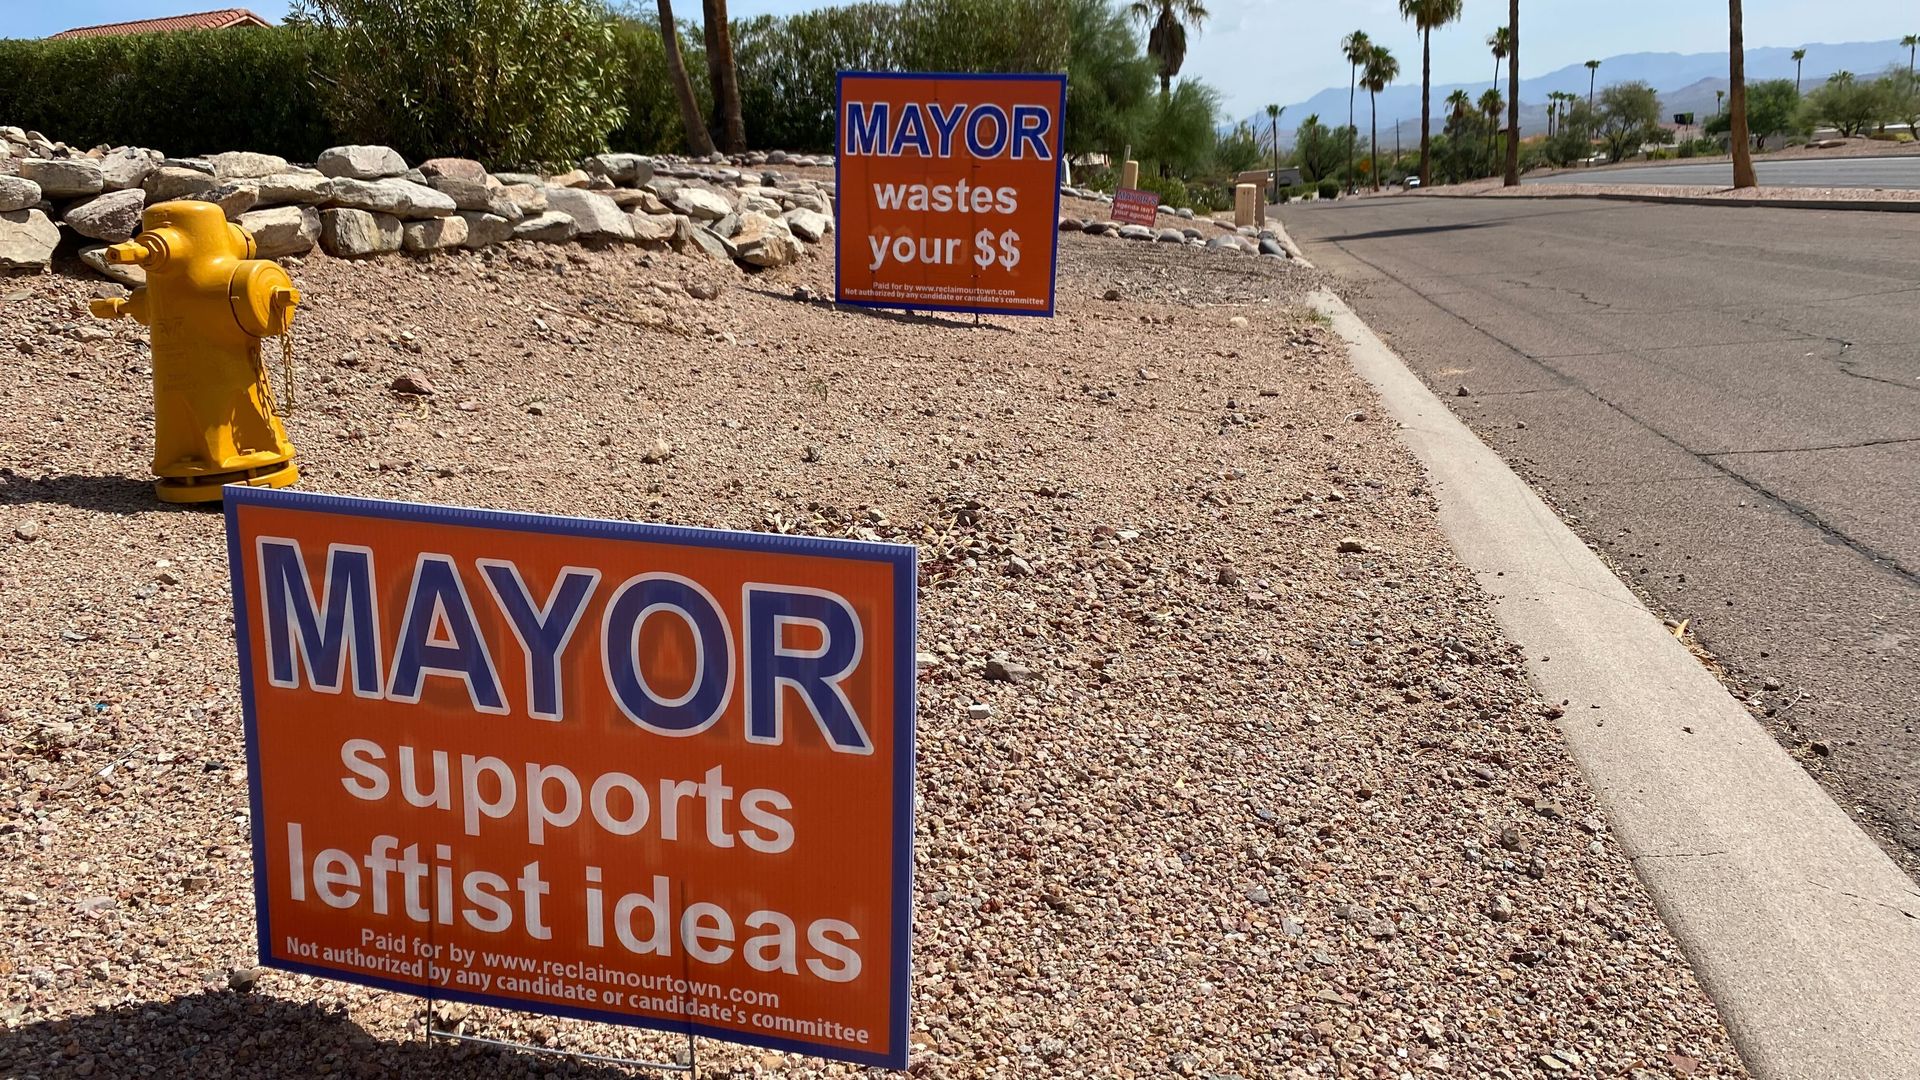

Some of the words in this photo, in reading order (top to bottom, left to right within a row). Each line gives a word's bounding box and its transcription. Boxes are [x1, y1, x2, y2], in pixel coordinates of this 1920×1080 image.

[845, 101, 1053, 161] MAYOR
[873, 178, 1018, 215] wastes
[1114, 208, 1129, 216] your
[1116, 202, 1139, 211] agenda
[868, 235, 961, 271] your
[973, 228, 1020, 272] $$
[858, 289, 897, 297] authorized
[897, 290, 905, 299] by
[906, 292, 919, 300] any
[920, 292, 954, 301] candidate
[964, 294, 1004, 303] candidate's
[1005, 296, 1044, 305] committee
[873, 281, 889, 290] Paid
[891, 282, 902, 290] for
[904, 283, 913, 292] by
[915, 285, 1015, 296] www.reclaimourtown.com
[255, 535, 874, 756] MAYOR
[340, 738, 795, 854] supports
[287, 822, 552, 941] leftist
[586, 867, 862, 983] ideas
[286, 936, 318, 959] Not
[322, 944, 423, 979] authorized
[428, 960, 451, 985] by
[456, 969, 492, 991] any
[497, 970, 597, 1002] candidate
[602, 986, 624, 1005] or
[629, 992, 747, 1024] candidate's
[752, 1011, 869, 1044] committee
[361, 928, 405, 954] Paid
[412, 937, 442, 960] for
[449, 943, 475, 968] by
[482, 952, 779, 1008] www.reclaimourtown.com
